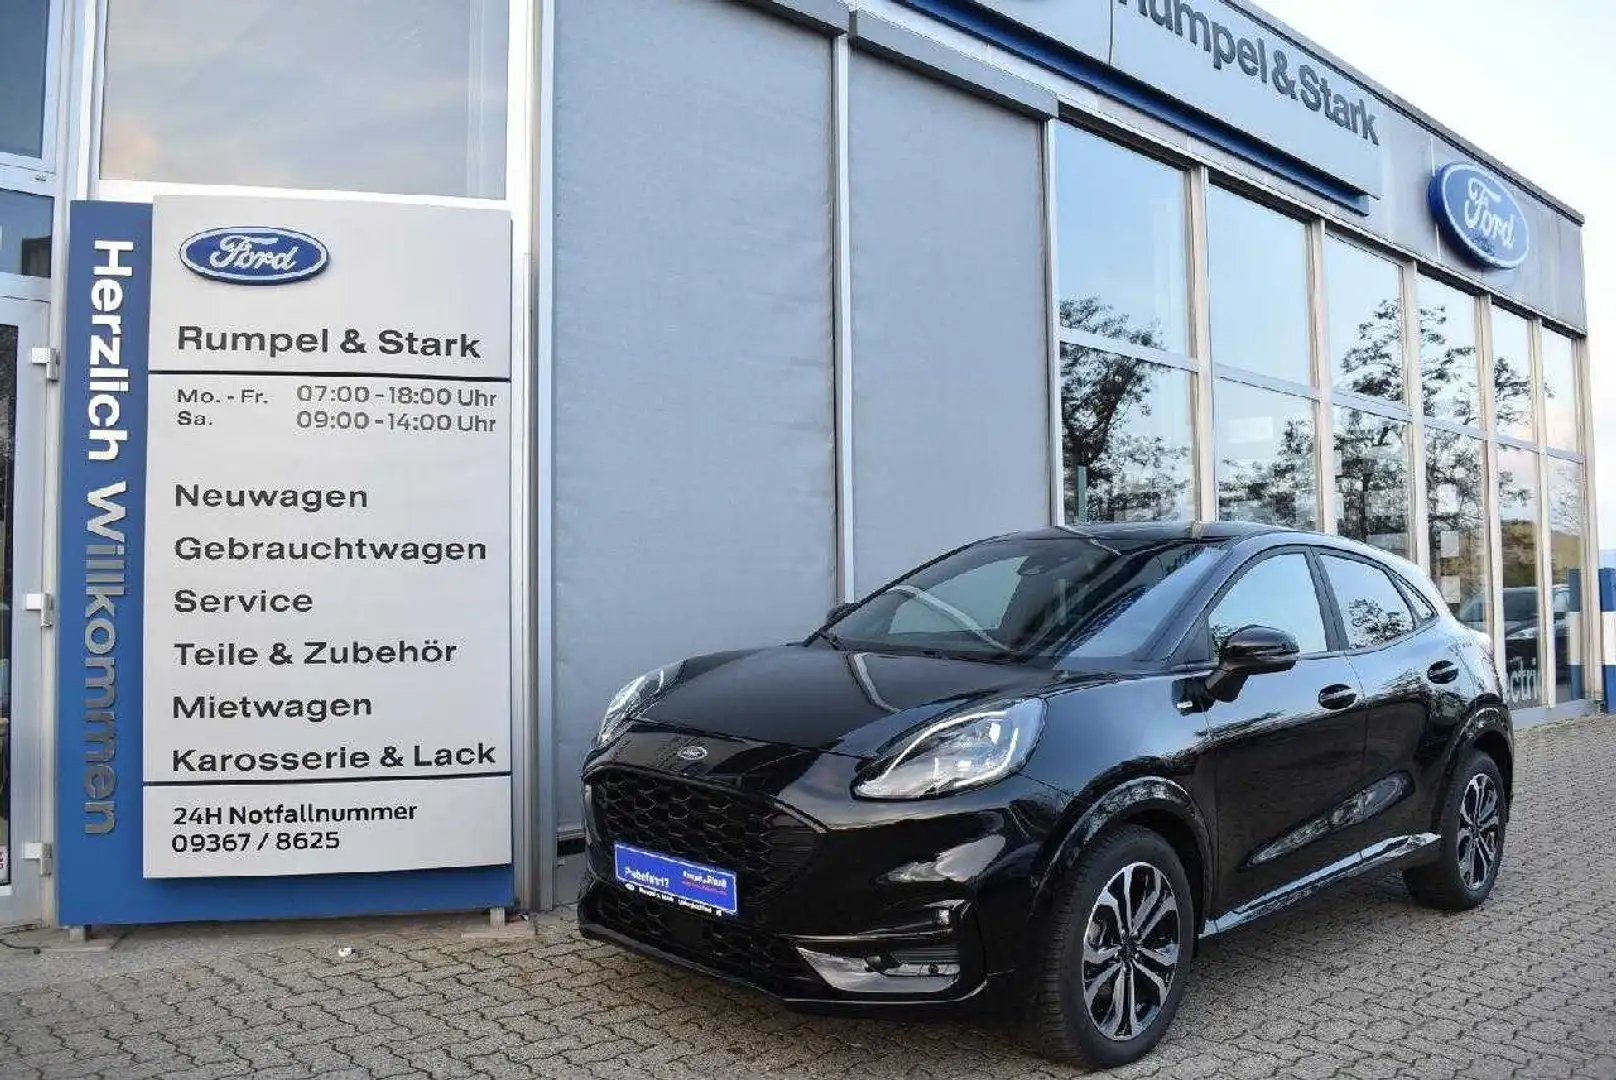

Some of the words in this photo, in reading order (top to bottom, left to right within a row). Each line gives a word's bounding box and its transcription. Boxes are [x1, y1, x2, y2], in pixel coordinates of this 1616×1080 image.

[210, 234, 300, 271] Ford
[87, 239, 134, 461] Herzlich
[178, 325, 328, 358] Rumpel
[339, 328, 367, 354] &
[378, 329, 481, 359] Stark
[177, 388, 221, 404] Mo.
[241, 389, 268, 404] Fr.
[457, 388, 497, 407] Uhr
[177, 410, 213, 426] Sa.
[457, 414, 497, 432] Uhr
[175, 484, 367, 513] Neuwagen
[174, 536, 486, 565] Gebrauchtwagen
[174, 589, 313, 613] Service
[82, 480, 127, 835] Willkommen
[173, 642, 259, 666] Teile
[268, 642, 294, 666] &
[303, 639, 457, 665] Zubehör
[173, 695, 372, 723] Mietwagen
[172, 746, 370, 773] Karosserie
[379, 744, 404, 768] &
[414, 742, 496, 767] Lack
[173, 806, 222, 825] 24H
[229, 803, 418, 825] Notfallnummer
[171, 832, 251, 853] 09367
[256, 832, 270, 851] /
[275, 831, 340, 851] 8625
